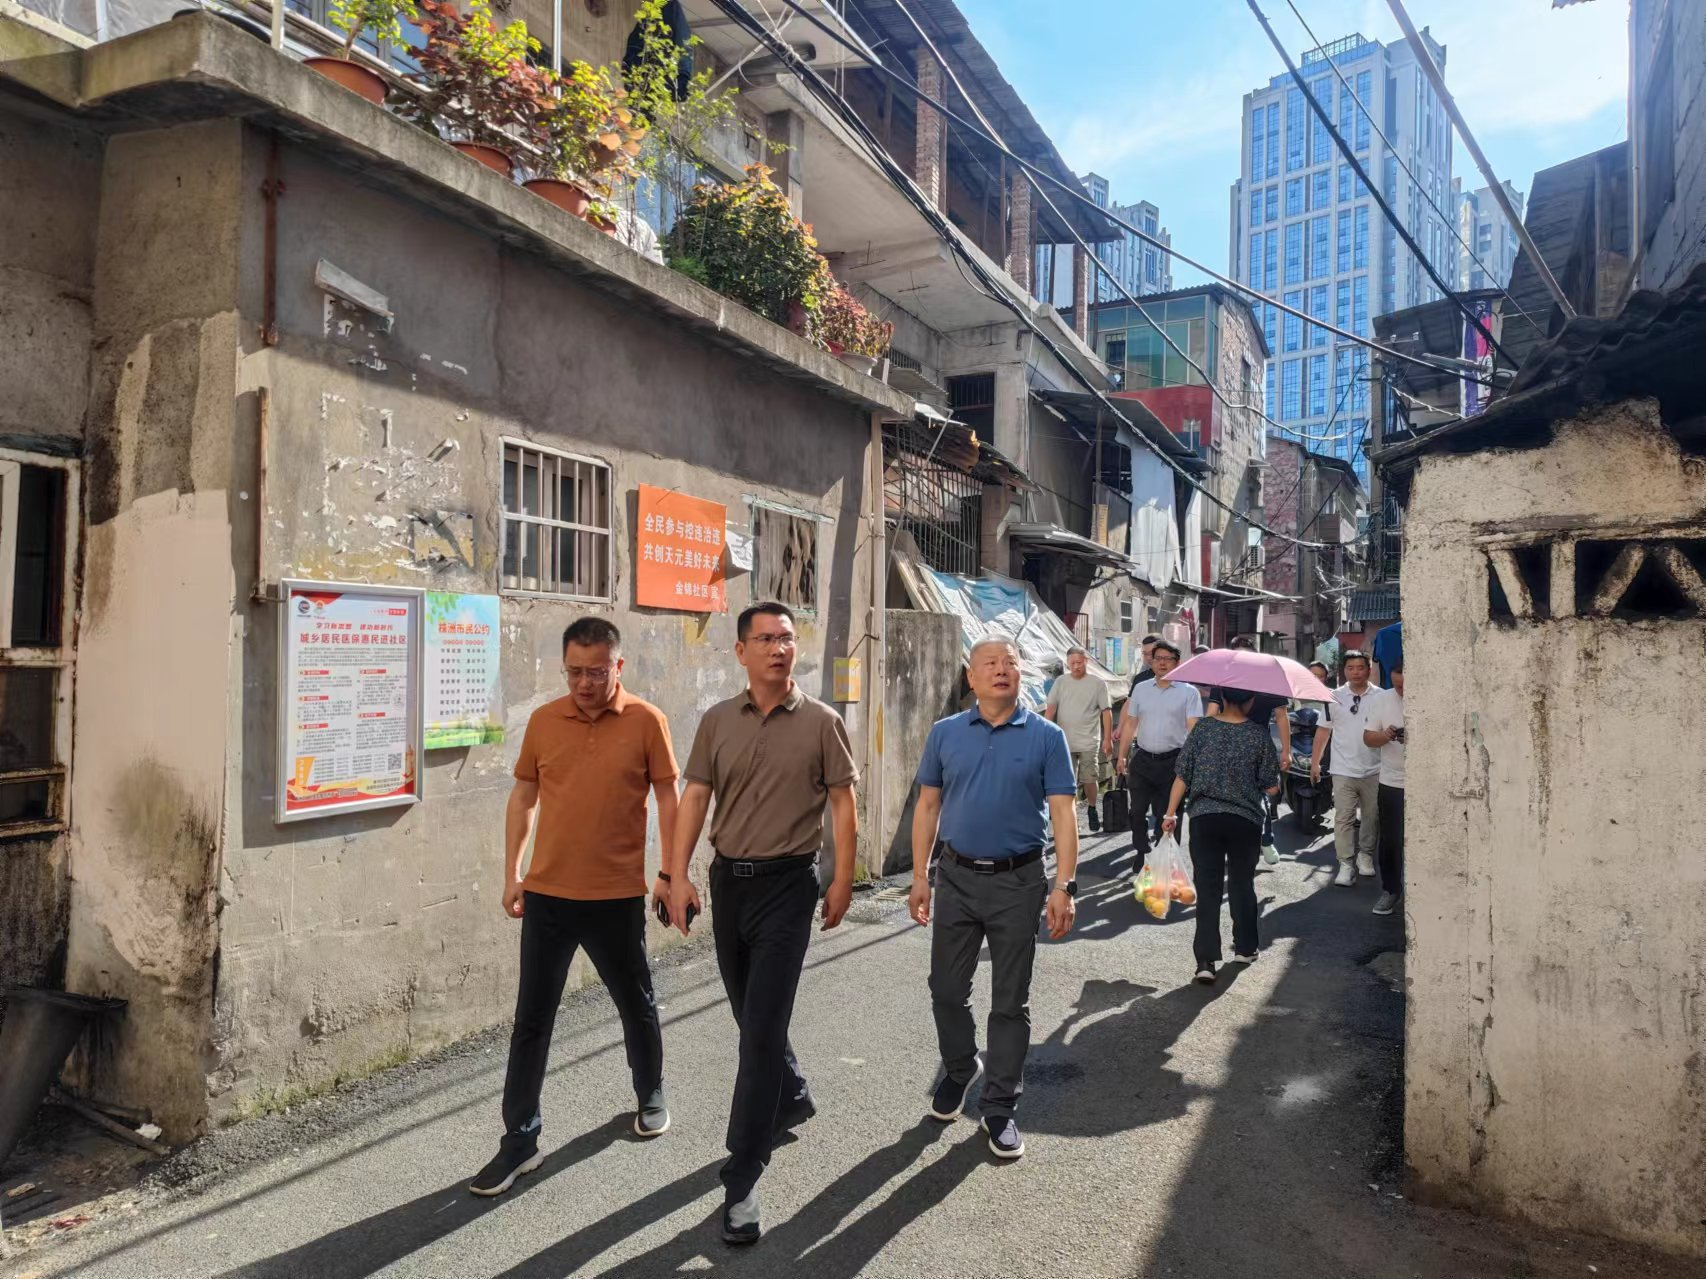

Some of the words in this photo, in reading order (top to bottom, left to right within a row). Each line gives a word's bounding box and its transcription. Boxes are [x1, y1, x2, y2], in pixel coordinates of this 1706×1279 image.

[644, 542, 719, 572] 共创天元美好未来
[439, 623, 489, 635] 株洲市民公约
[300, 633, 406, 644] 城乡居民医保惠民进社区
